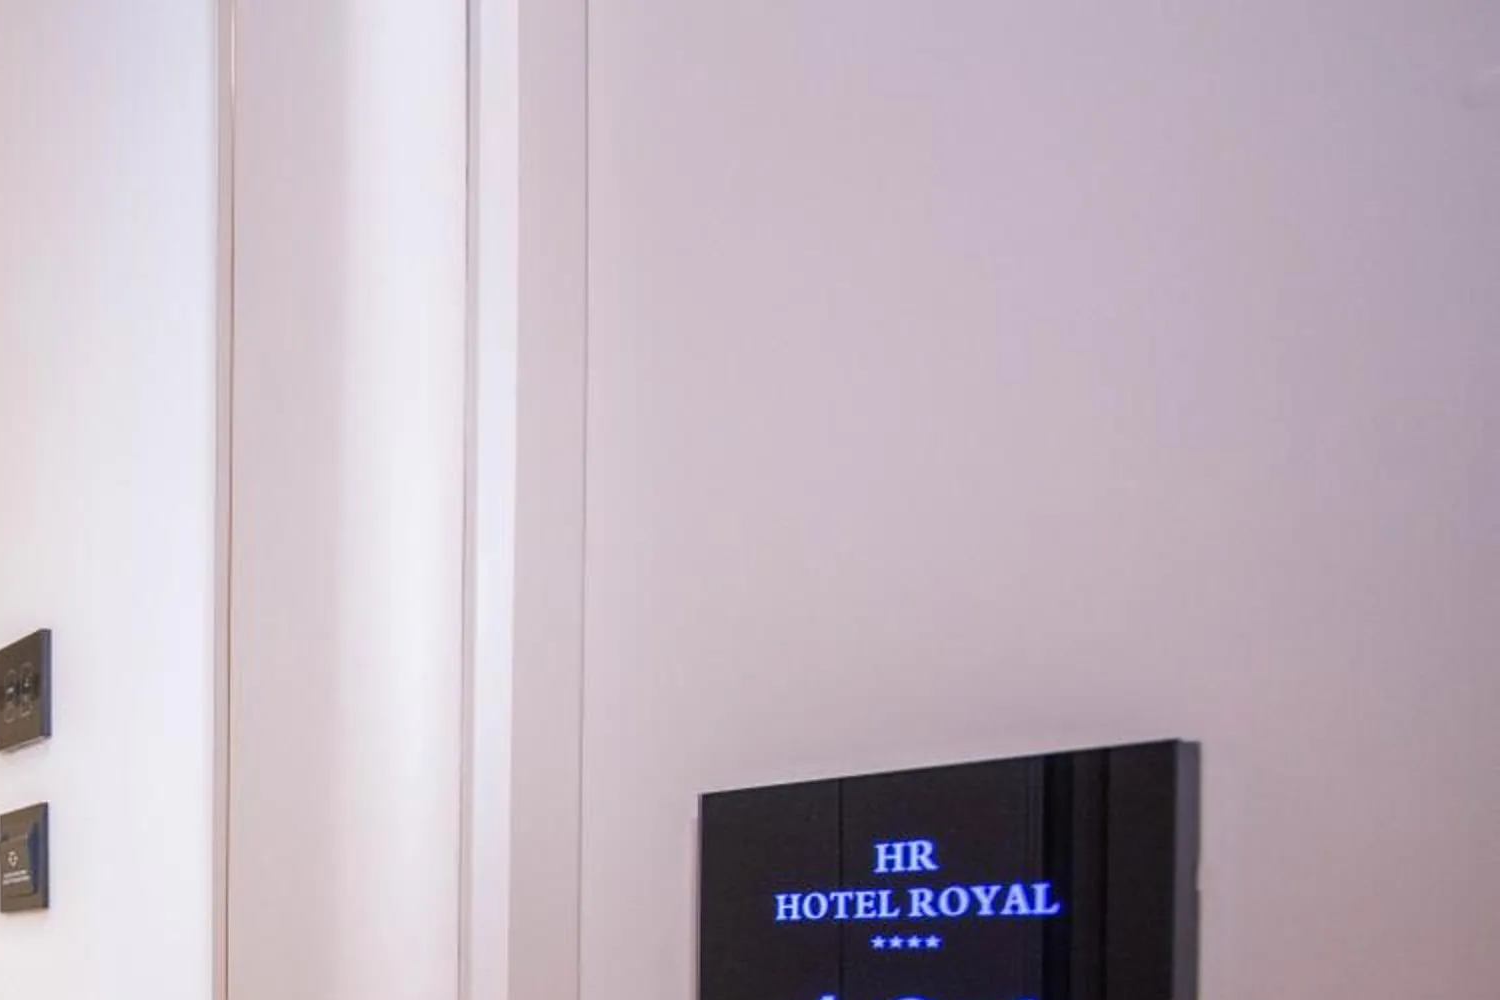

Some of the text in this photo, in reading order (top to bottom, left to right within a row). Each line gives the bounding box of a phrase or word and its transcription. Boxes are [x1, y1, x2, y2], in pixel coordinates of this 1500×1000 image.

[873, 840, 938, 873] HR
[775, 882, 1061, 920] HOTEL ROYAL
